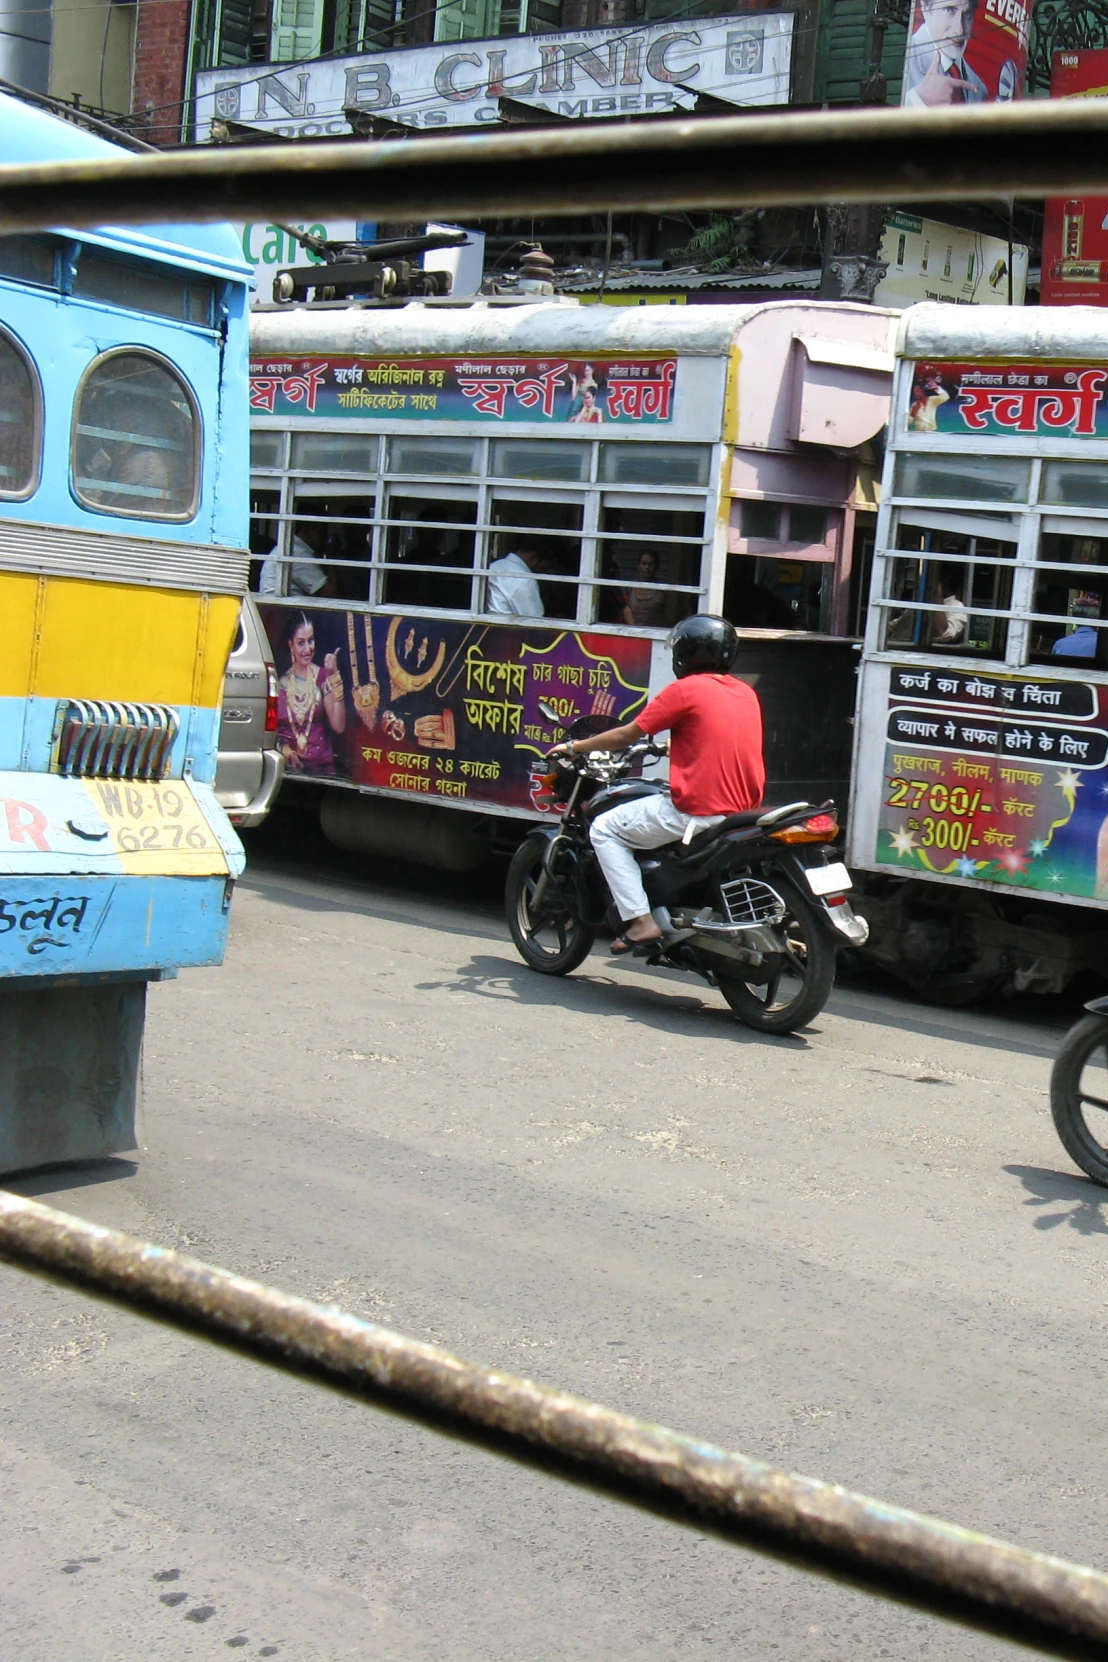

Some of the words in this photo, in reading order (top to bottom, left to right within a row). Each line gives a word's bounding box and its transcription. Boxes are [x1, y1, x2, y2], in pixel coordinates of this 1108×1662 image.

[434, 32, 702, 101] CLINIC
[894, 215, 922, 230] Batteries
[243, 221, 327, 265] Care
[458, 363, 568, 419] স্বর্গ
[607, 362, 676, 420] स्वर्ग
[1033, 376, 1049, 387] का
[410, 393, 438, 410] সাথে
[958, 370, 1108, 435] स्वर्ग
[465, 644, 528, 697] বিশেষ
[532, 662, 553, 683] চার
[557, 664, 584, 688] গাছা
[899, 672, 931, 692] कर्ज
[937, 680, 958, 697] का
[965, 676, 997, 702] बोझ
[1022, 684, 1062, 709] चिंता
[463, 698, 525, 736] অফার
[897, 719, 939, 741] व्यापार
[961, 727, 998, 749] सफल
[1005, 729, 1032, 755] होने
[1038, 731, 1054, 756] के
[1059, 736, 1089, 761] लिए
[361, 746, 382, 763] কম
[386, 750, 431, 771] ওজনের
[435, 756, 454, 774] ২৪
[459, 759, 501, 780] ক্যারেট
[1000, 767, 1044, 790] माणक
[389, 771, 431, 792] সোনার
[435, 779, 467, 798] গহনা
[889, 777, 992, 818] 2700/-
[117, 824, 207, 853] 6276
[921, 816, 979, 853] 300/-
